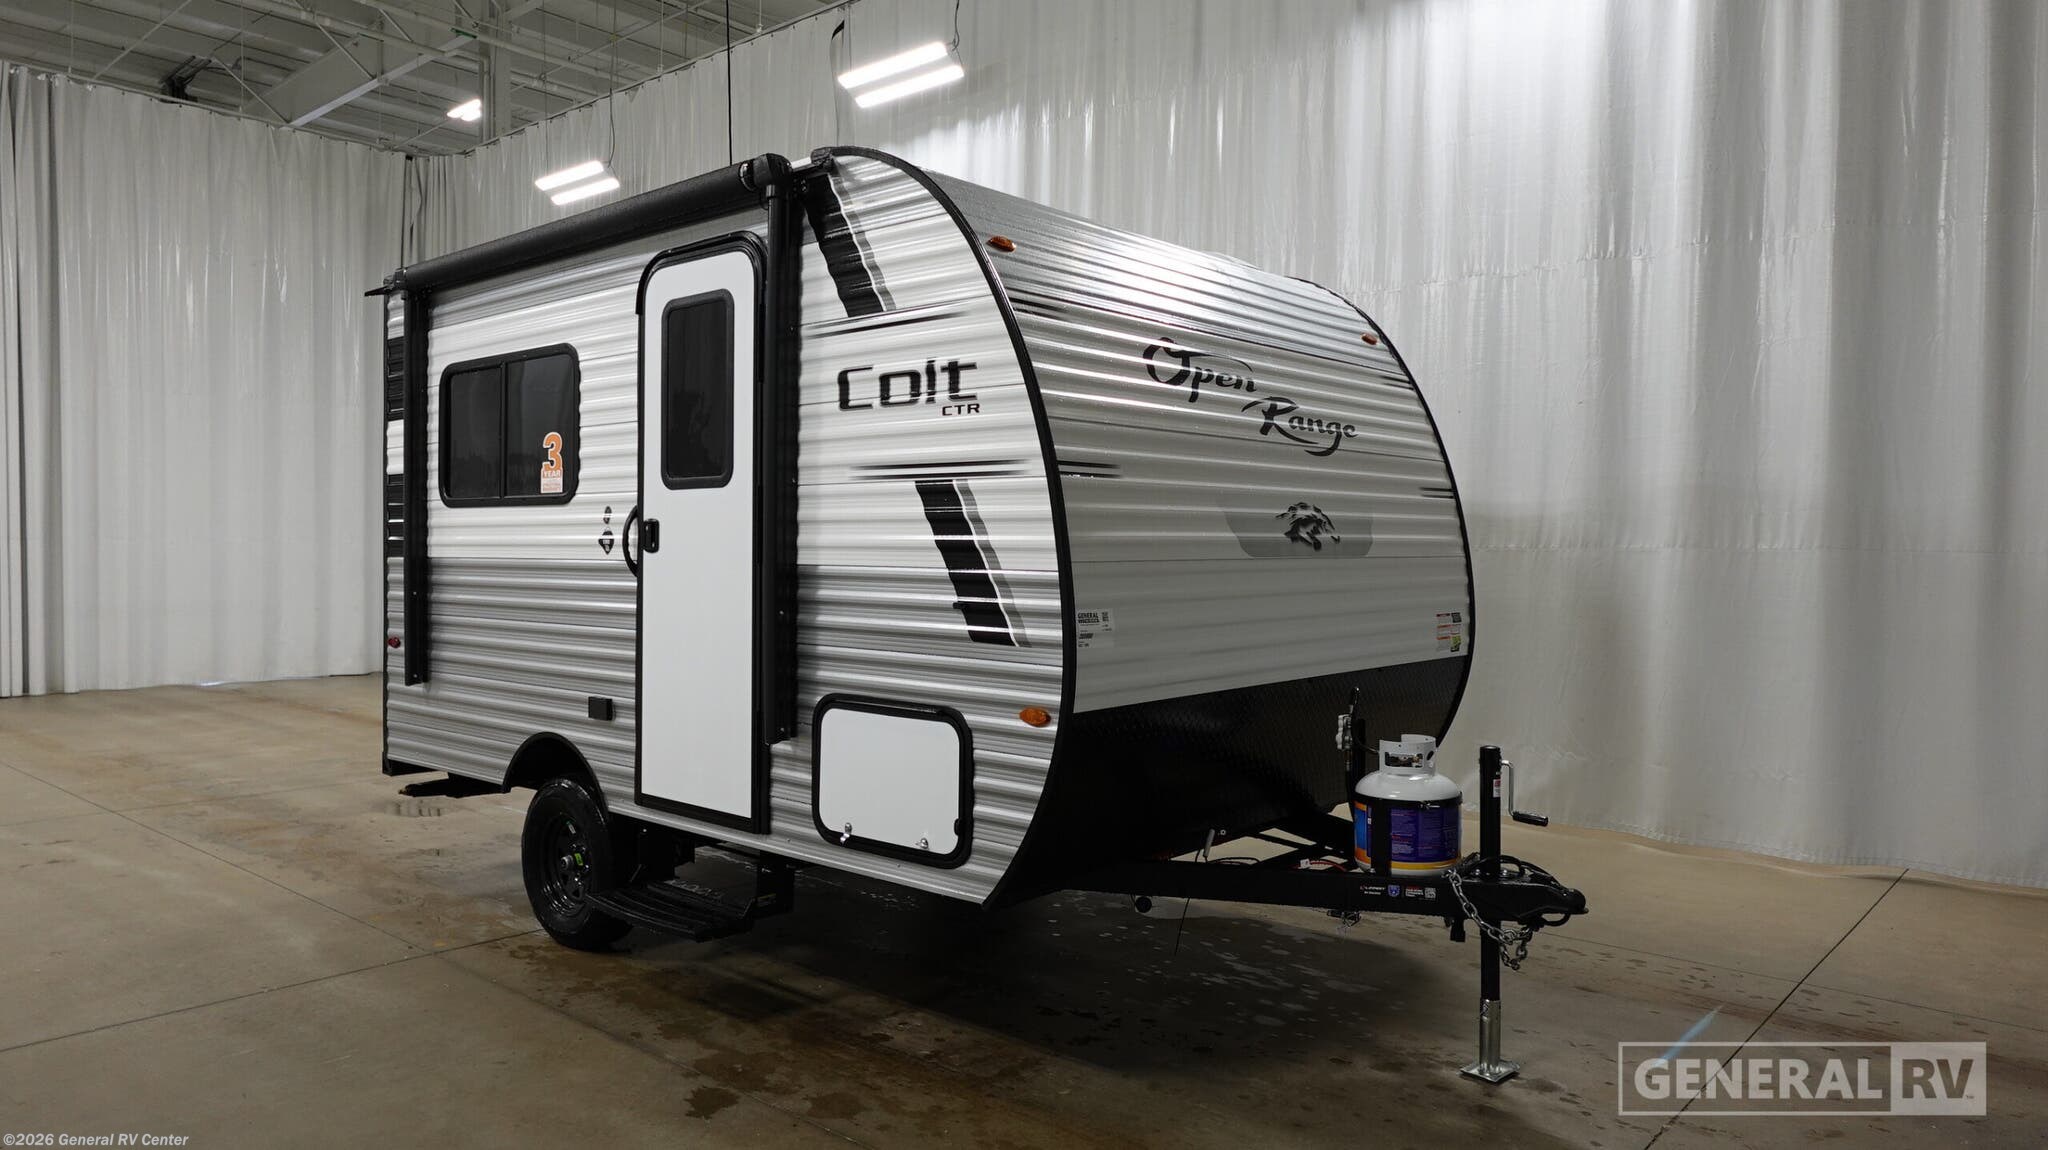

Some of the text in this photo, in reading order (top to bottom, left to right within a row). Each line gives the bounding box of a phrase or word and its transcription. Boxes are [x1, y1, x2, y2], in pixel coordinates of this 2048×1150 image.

[837, 358, 977, 411] Colt
[1143, 337, 1257, 403] Open
[942, 403, 980, 416] CTR
[1241, 396, 1359, 457] Range
[542, 431, 563, 471] 3
[543, 469, 561, 478] YEAR
